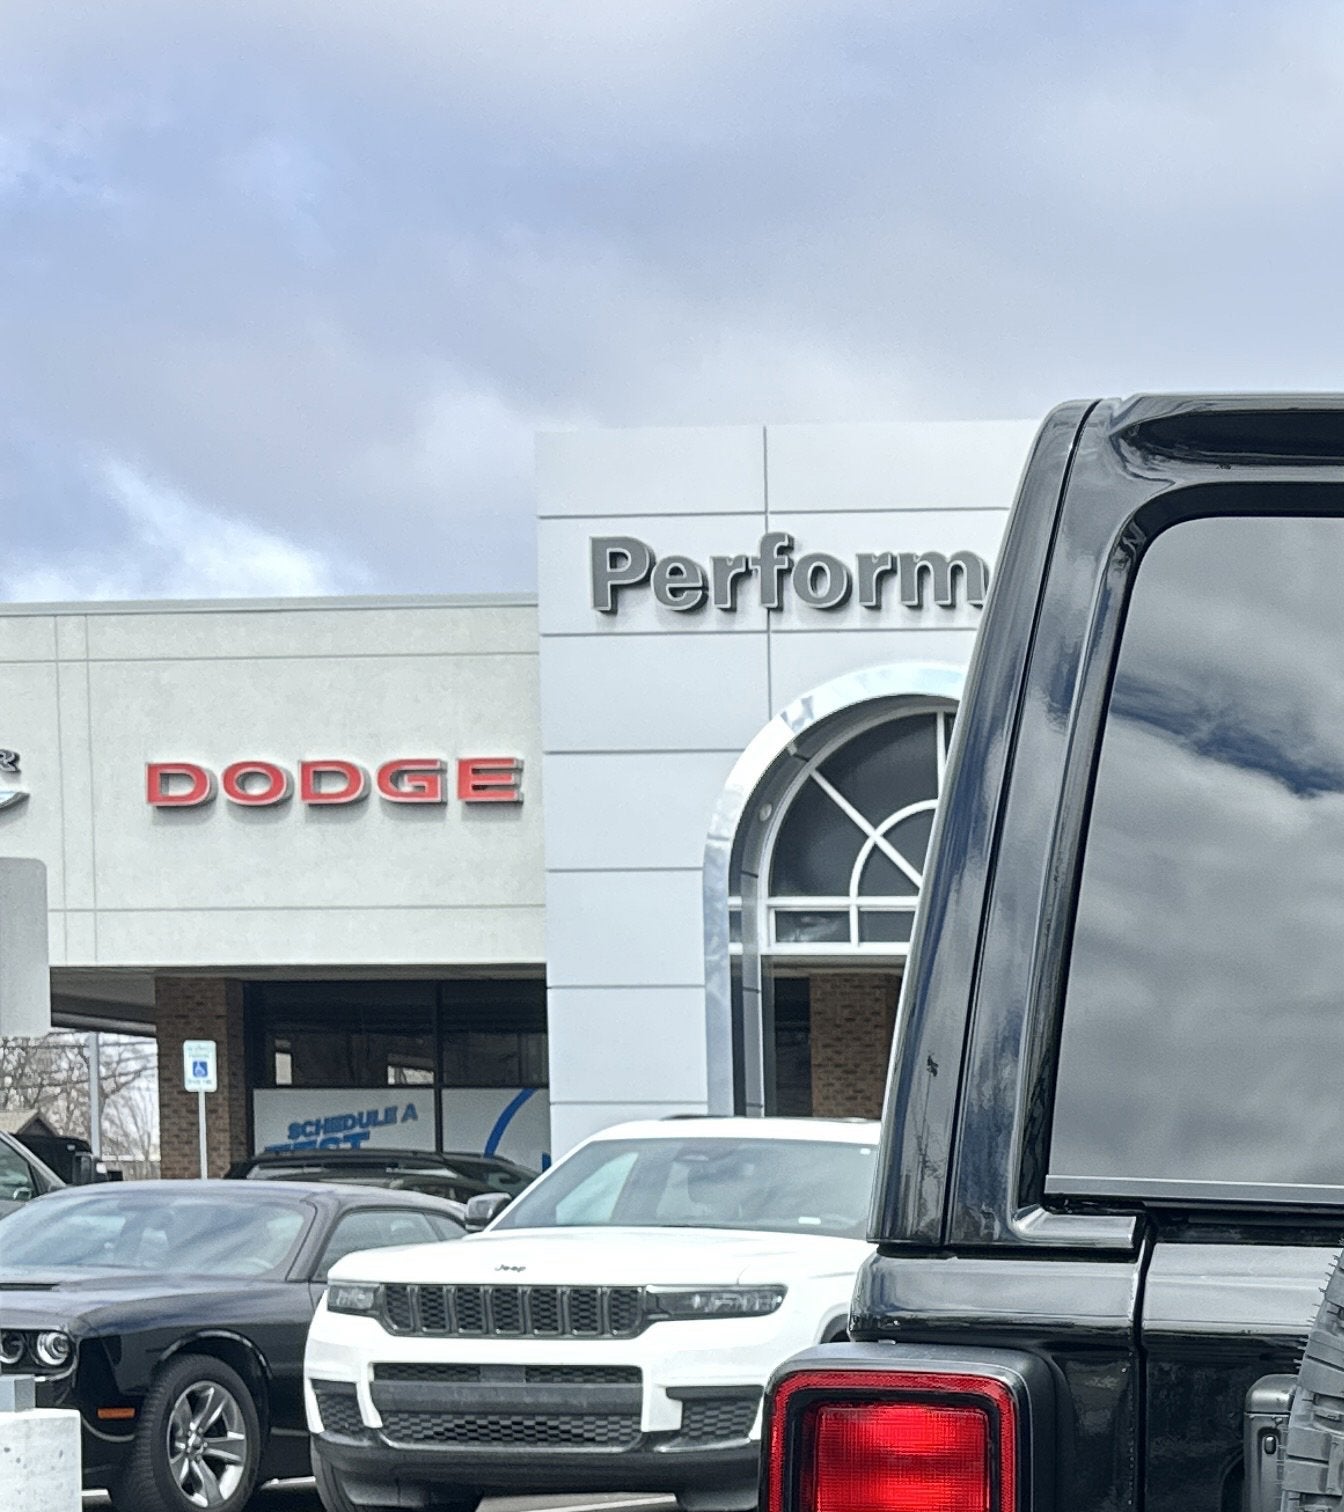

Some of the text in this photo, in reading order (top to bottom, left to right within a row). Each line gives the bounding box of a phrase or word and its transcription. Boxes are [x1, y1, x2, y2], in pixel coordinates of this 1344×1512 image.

[590, 531, 990, 613] Perform
[146, 757, 523, 807] DODGE
[288, 1102, 418, 1140] SCHEDULE A
